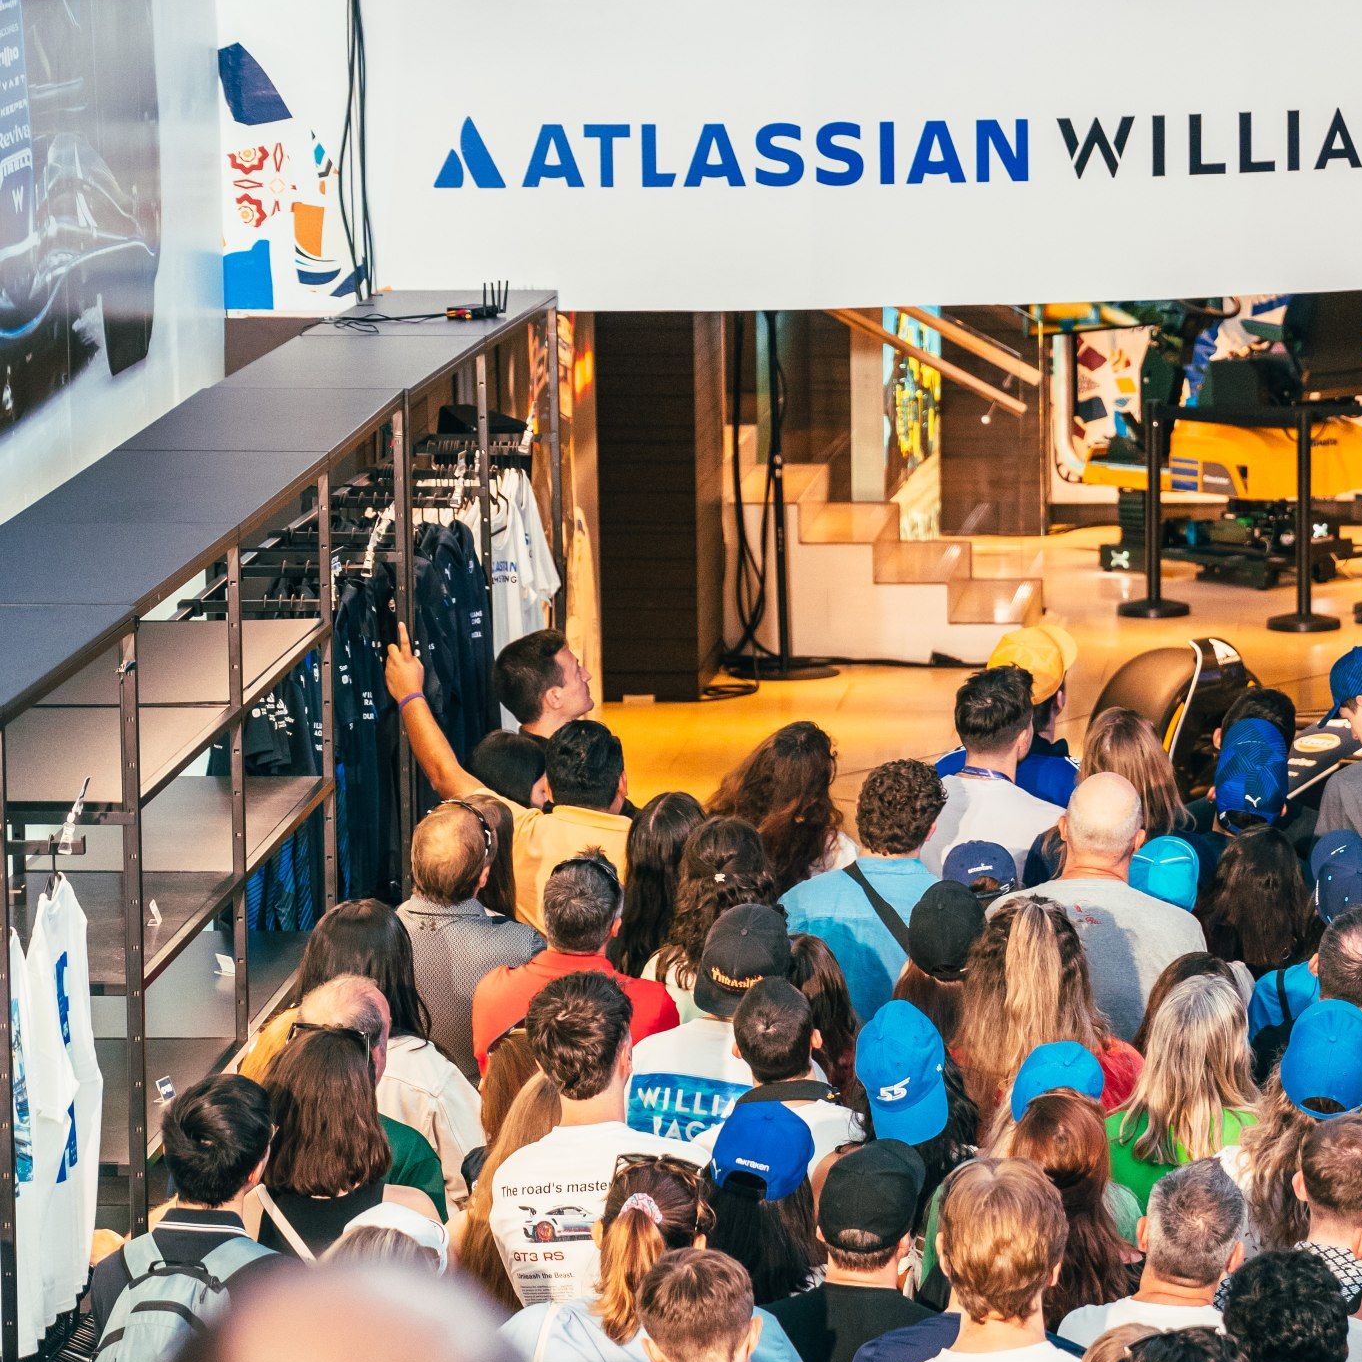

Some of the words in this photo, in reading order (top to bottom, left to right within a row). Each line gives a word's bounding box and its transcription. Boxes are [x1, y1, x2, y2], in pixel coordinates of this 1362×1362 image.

[522, 119, 1030, 188] ATLASSIAN
[876, 1076, 912, 1102] 55
[743, 1158, 770, 1172] kraken
[501, 1185, 518, 1197] The
[521, 1182, 563, 1196] road's
[513, 1251, 539, 1262] GT3
[543, 1251, 565, 1262] RS
